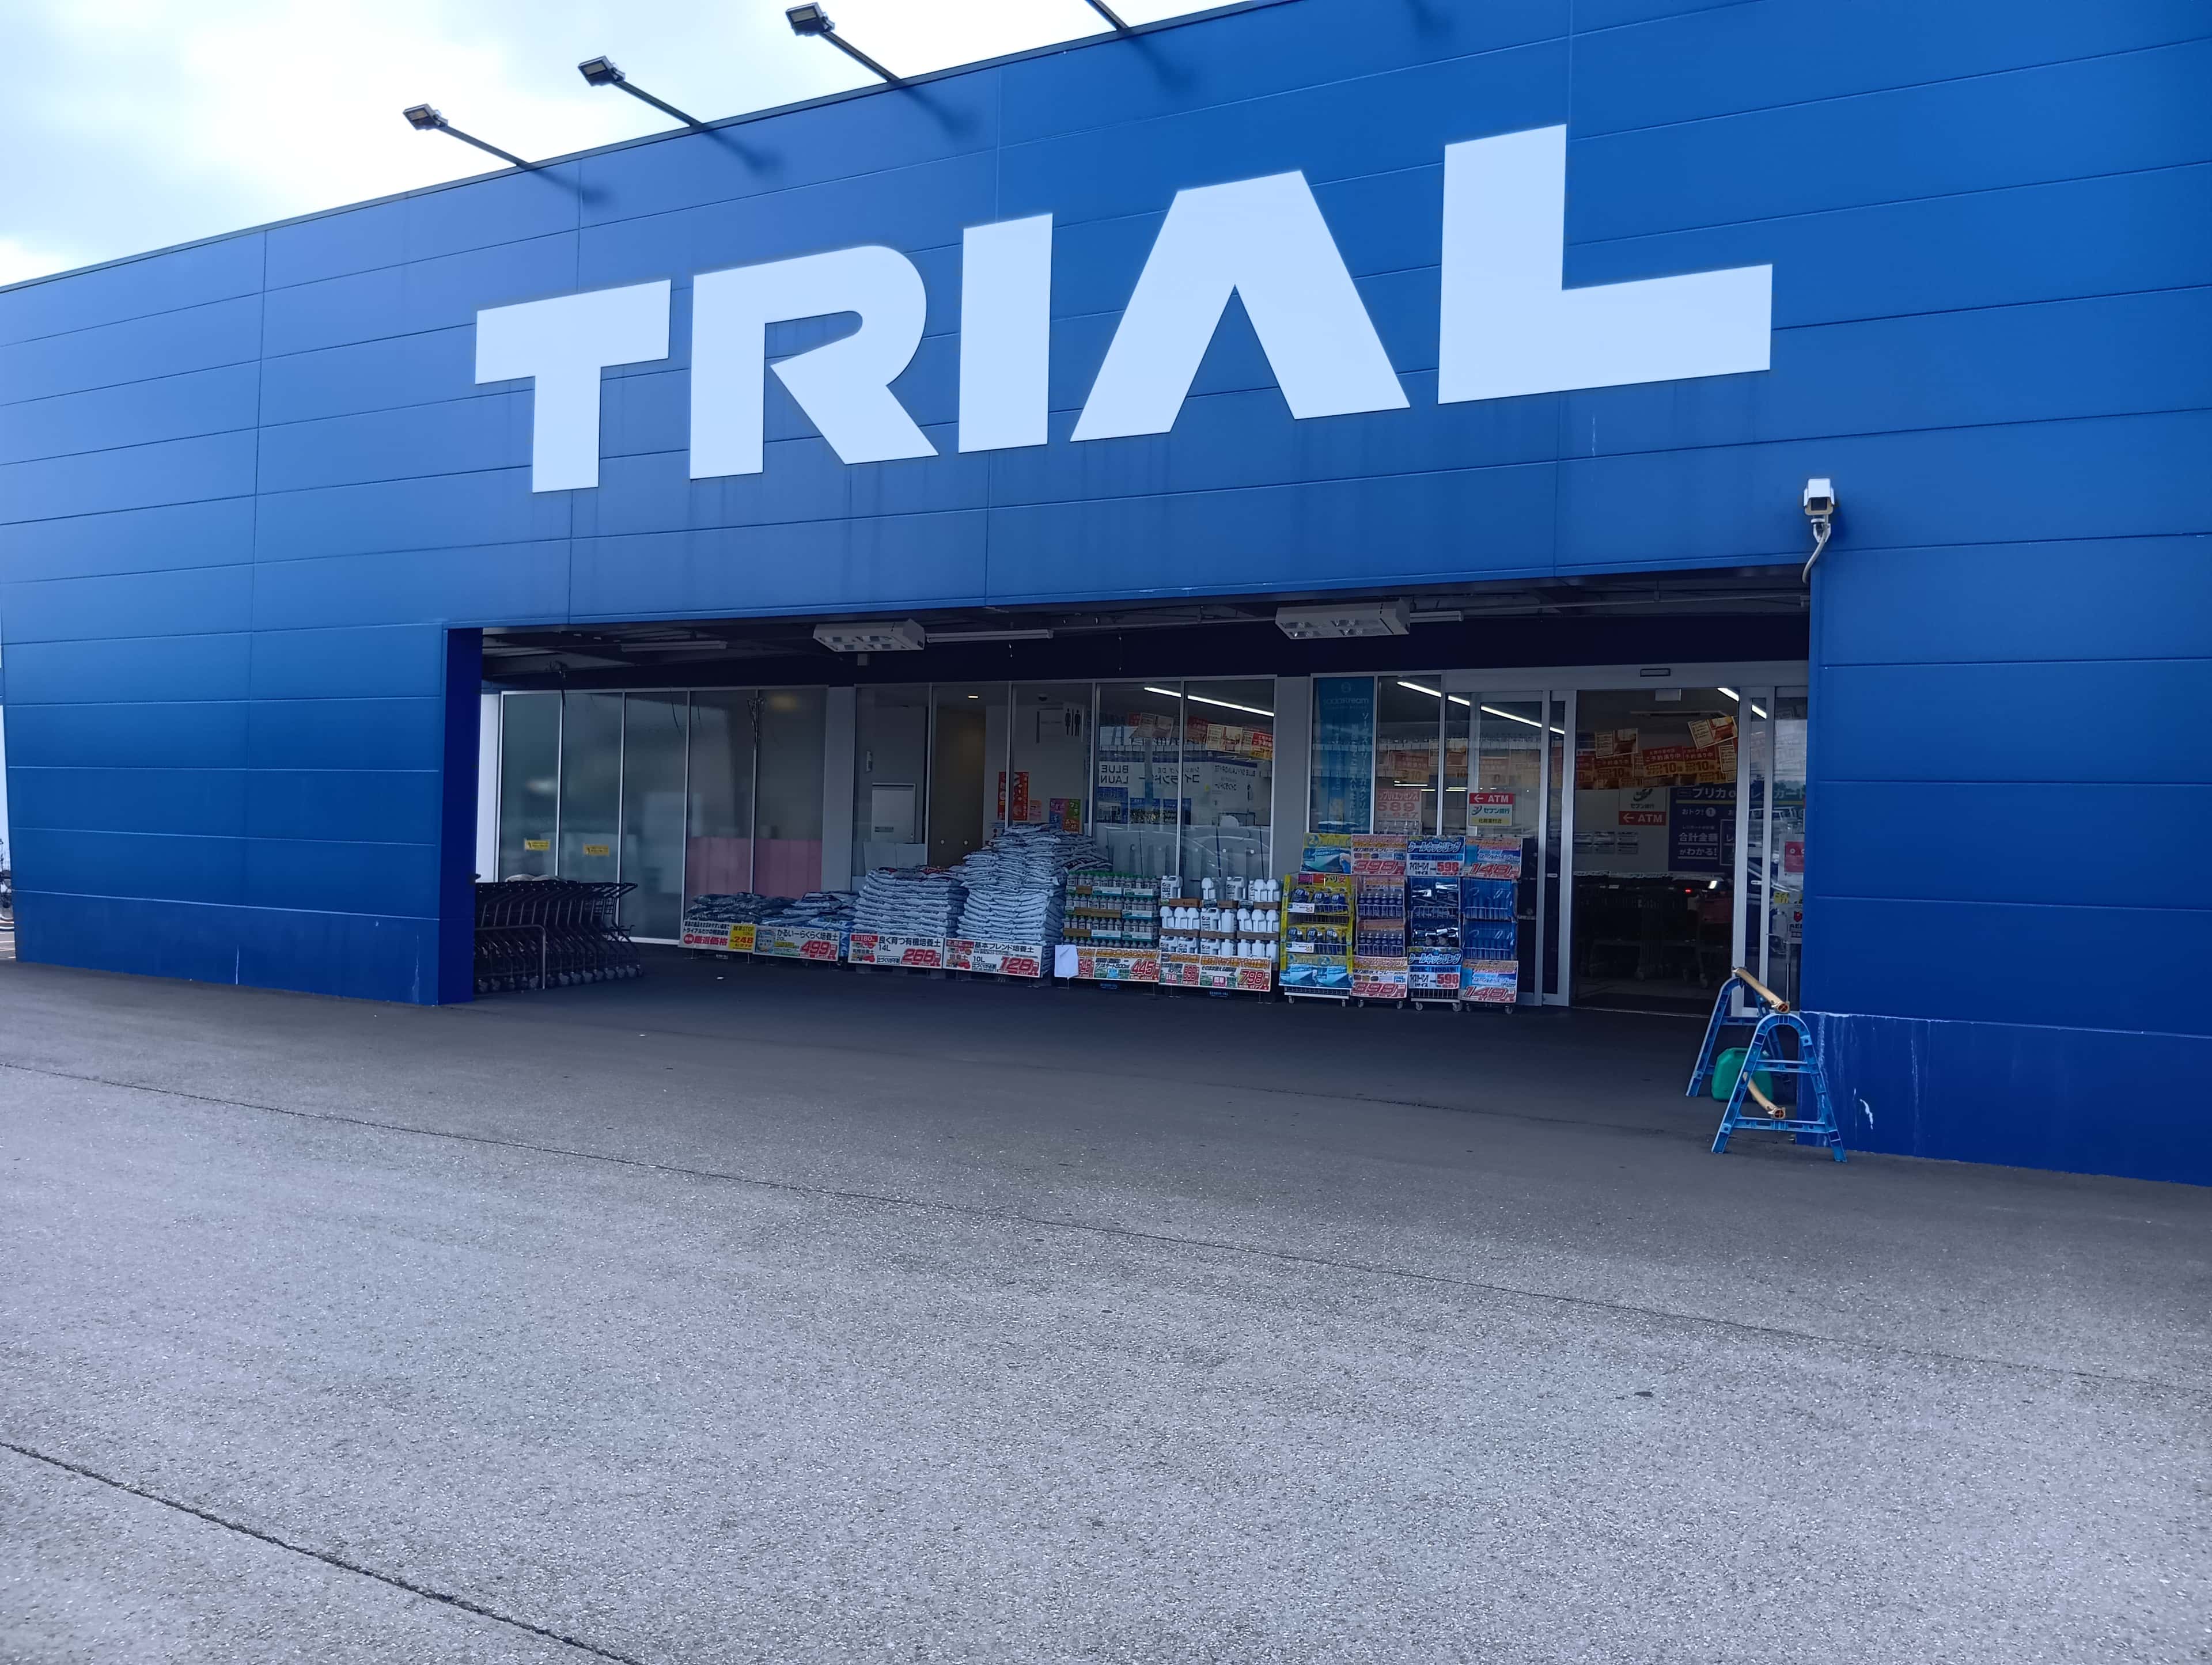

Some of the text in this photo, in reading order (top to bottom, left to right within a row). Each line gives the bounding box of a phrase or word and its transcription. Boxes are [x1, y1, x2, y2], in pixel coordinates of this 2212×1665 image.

[475, 124, 1773, 494] TRIAL
[1378, 802, 1415, 811] 589
[1483, 807, 1510, 815] セブン銀行
[1637, 814, 1663, 823] ATM
[1679, 833, 1719, 843] 合計金額
[1407, 841, 1461, 854] クールネックリング
[1679, 847, 1718, 856] がわかる!
[1437, 862, 1459, 872] 598
[734, 936, 753, 944] 248
[878, 935, 941, 947] 良く育つ有機培養土
[975, 941, 1035, 954] 基本ブレンド培養土
[1407, 953, 1461, 965] クールネックリング
[1437, 974, 1459, 984] 598
